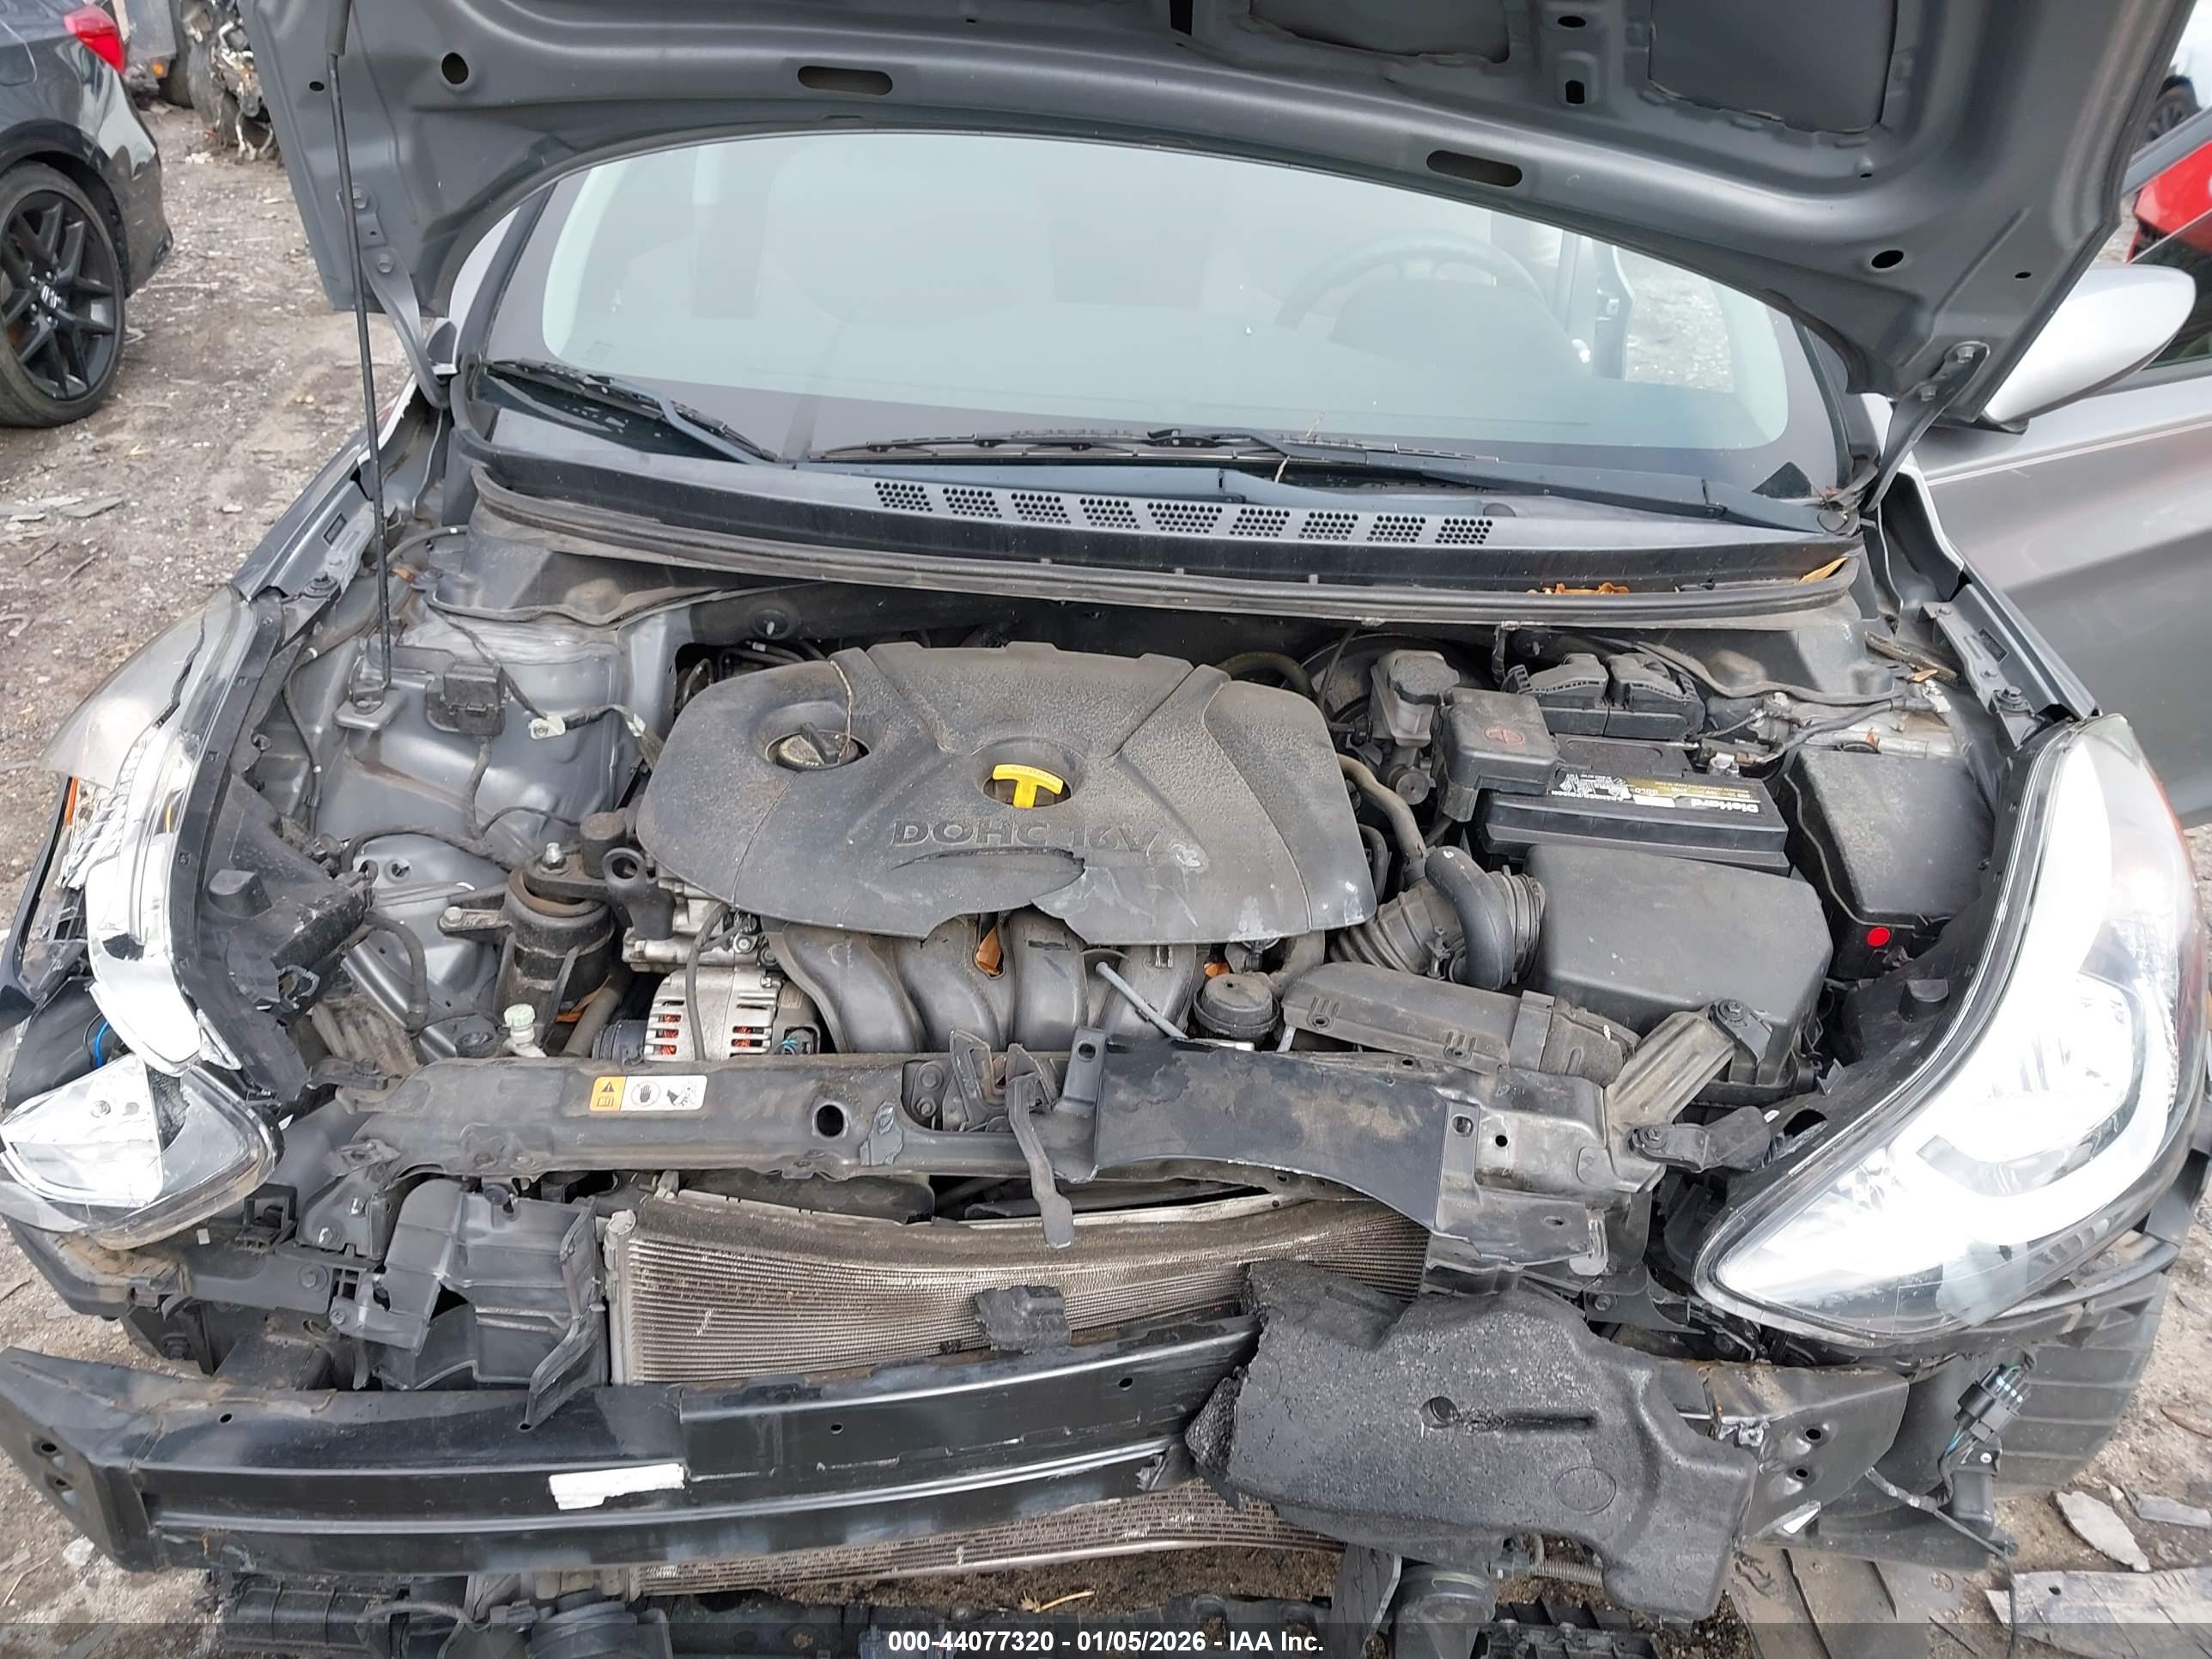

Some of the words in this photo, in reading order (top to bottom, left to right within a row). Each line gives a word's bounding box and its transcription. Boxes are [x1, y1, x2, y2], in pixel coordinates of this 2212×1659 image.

[1691, 798, 1759, 813] DieHard
[890, 821, 1050, 847] DOHC
[1065, 823, 1160, 852] 16V
